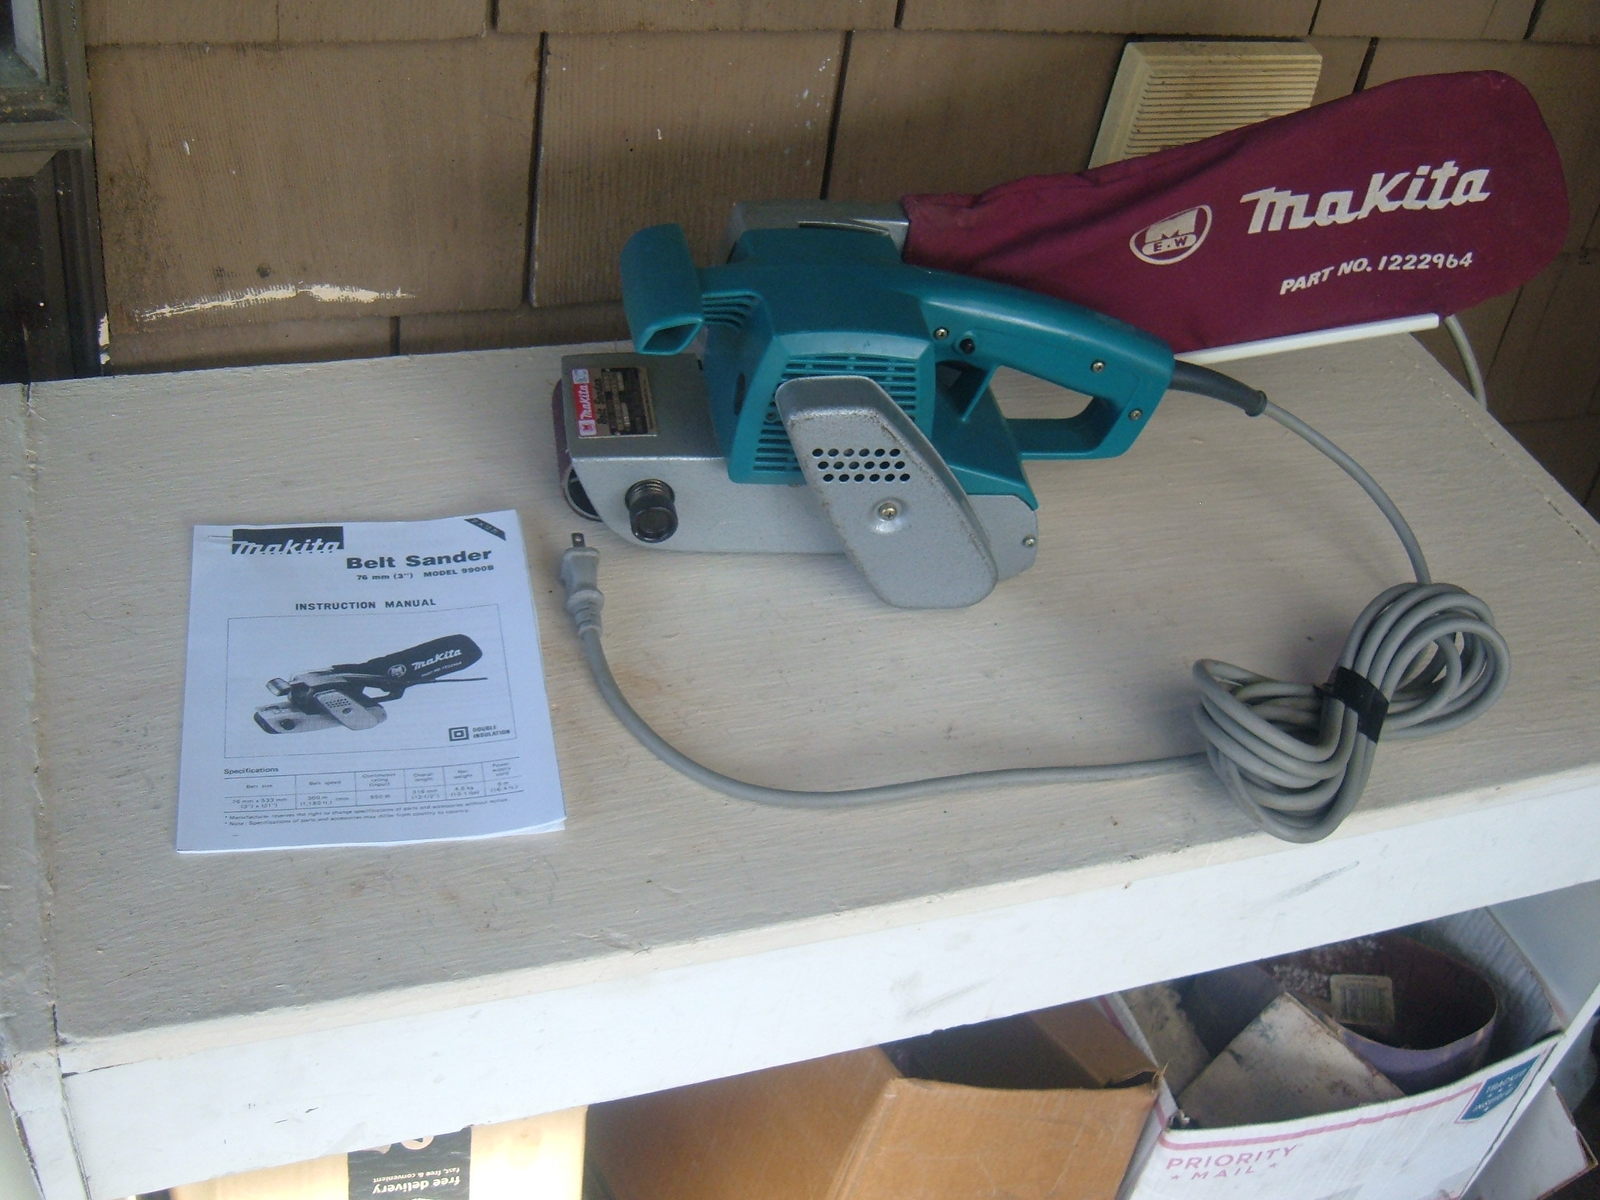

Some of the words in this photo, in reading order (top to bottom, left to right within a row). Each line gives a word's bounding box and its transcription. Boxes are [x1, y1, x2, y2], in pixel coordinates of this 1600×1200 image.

[1279, 266, 1334, 295] PART
[1337, 257, 1373, 276] NO.
[1377, 252, 1473, 271] 1222964
[346, 556, 396, 569] Belt
[405, 550, 492, 567] Sander
[423, 569, 458, 578] MODEL
[461, 565, 494, 574] 9900B
[295, 600, 377, 611] INSTRUCTION
[385, 599, 436, 609] MANUAL
[223, 767, 279, 775] Specifications
[1166, 1144, 1298, 1170] PRIORITY
[373, 1173, 416, 1183] convenient
[1191, 1166, 1255, 1180] MAIL
[372, 1180, 433, 1195] delivery
[432, 1175, 461, 1187] free
